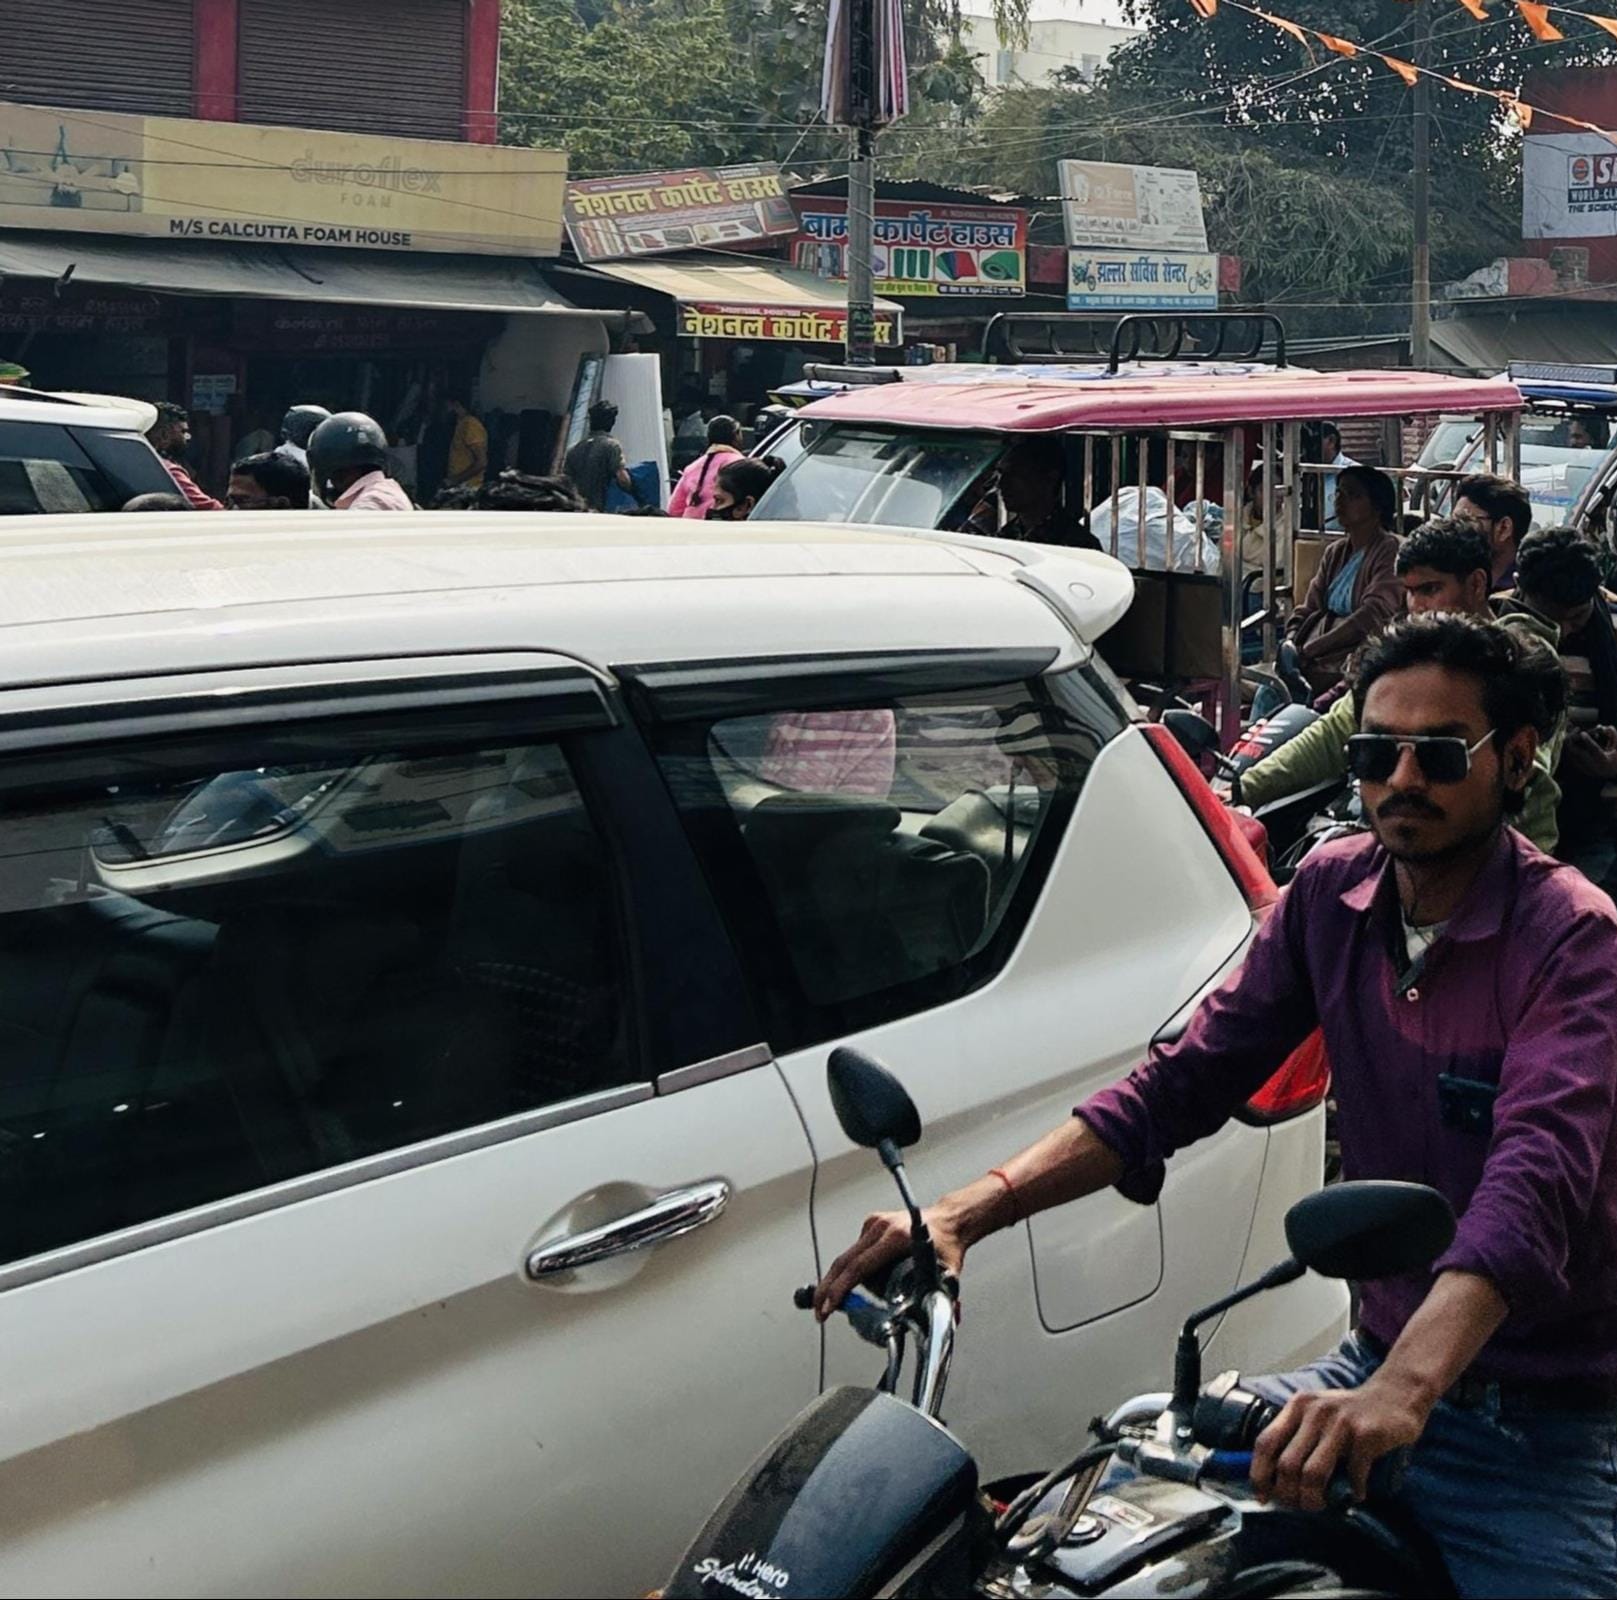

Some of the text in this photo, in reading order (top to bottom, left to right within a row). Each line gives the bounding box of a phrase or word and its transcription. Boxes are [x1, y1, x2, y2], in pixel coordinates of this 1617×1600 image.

[291, 149, 442, 192] duroflex
[340, 193, 392, 208] FOAM
[568, 188, 656, 217] नेशनल
[725, 174, 784, 202] हाउस
[1568, 204, 1587, 214] THE
[170, 219, 412, 247] M/S CALCUTTA FOAM HOUSE
[950, 221, 1016, 248] हाउस
[751, 1559, 790, 1589] Hero
